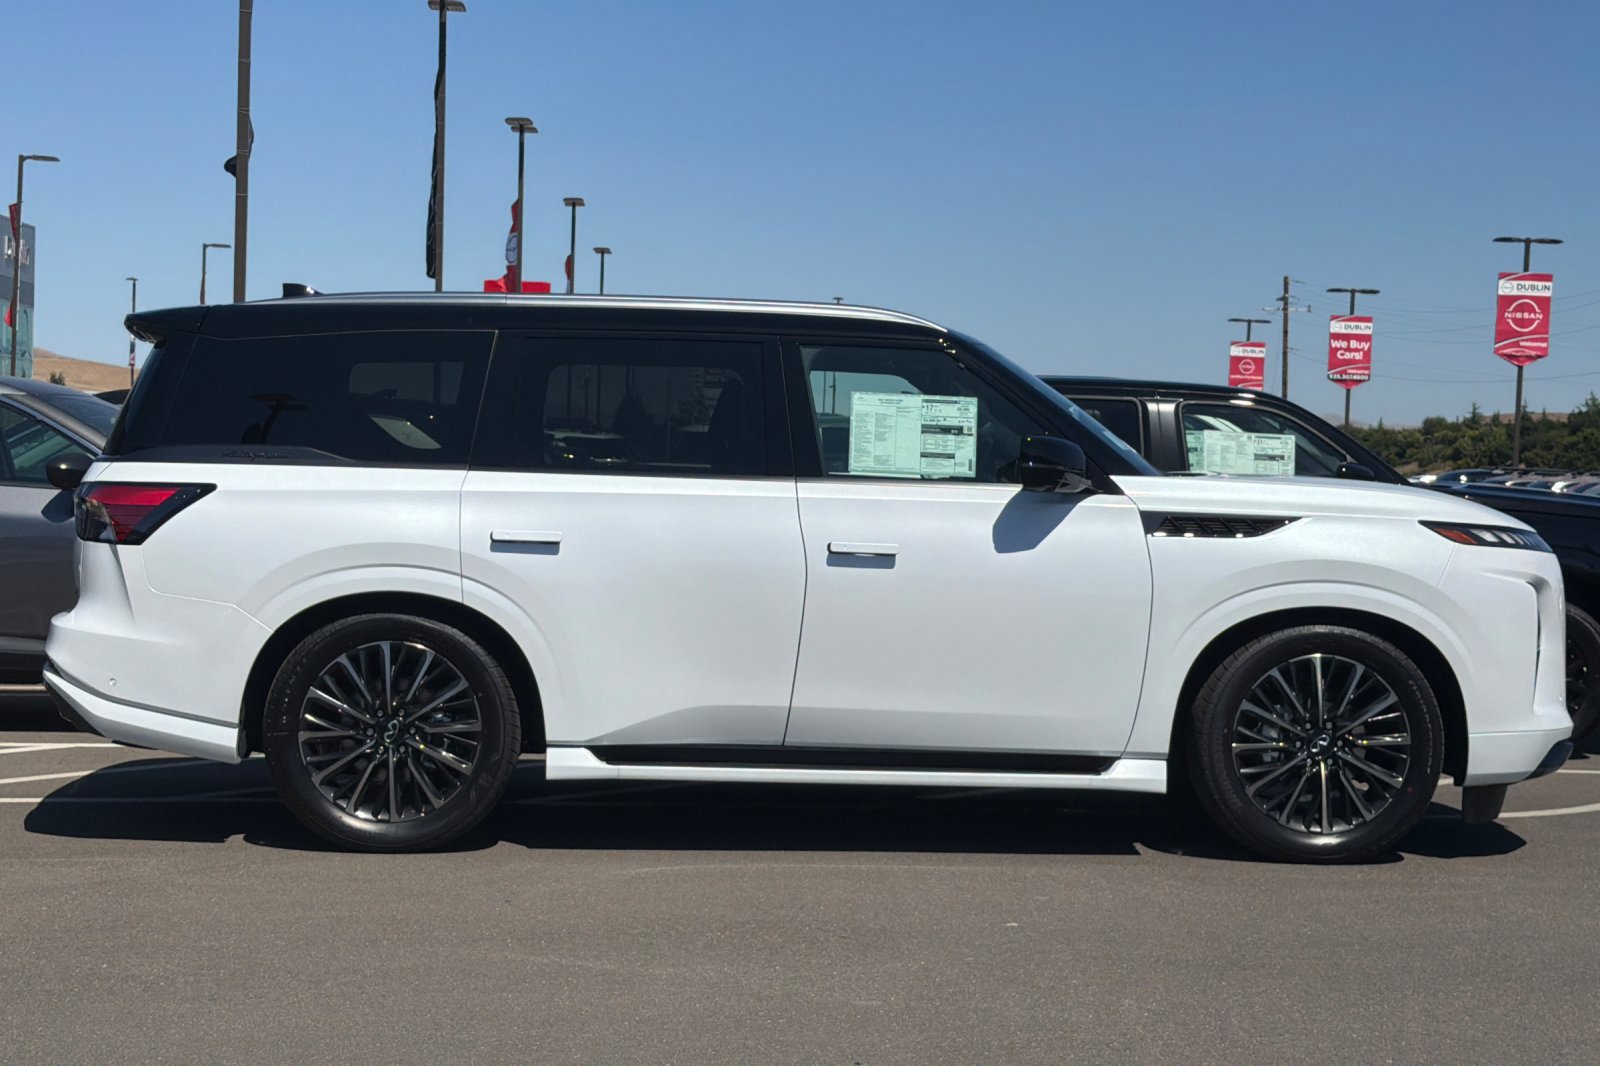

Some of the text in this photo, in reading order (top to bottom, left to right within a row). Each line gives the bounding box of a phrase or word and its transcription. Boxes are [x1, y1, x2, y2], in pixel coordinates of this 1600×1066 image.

[1516, 283, 1551, 292] DUBLIN
[1331, 339, 1371, 351] We Buy
[1336, 350, 1364, 360] Cars!
